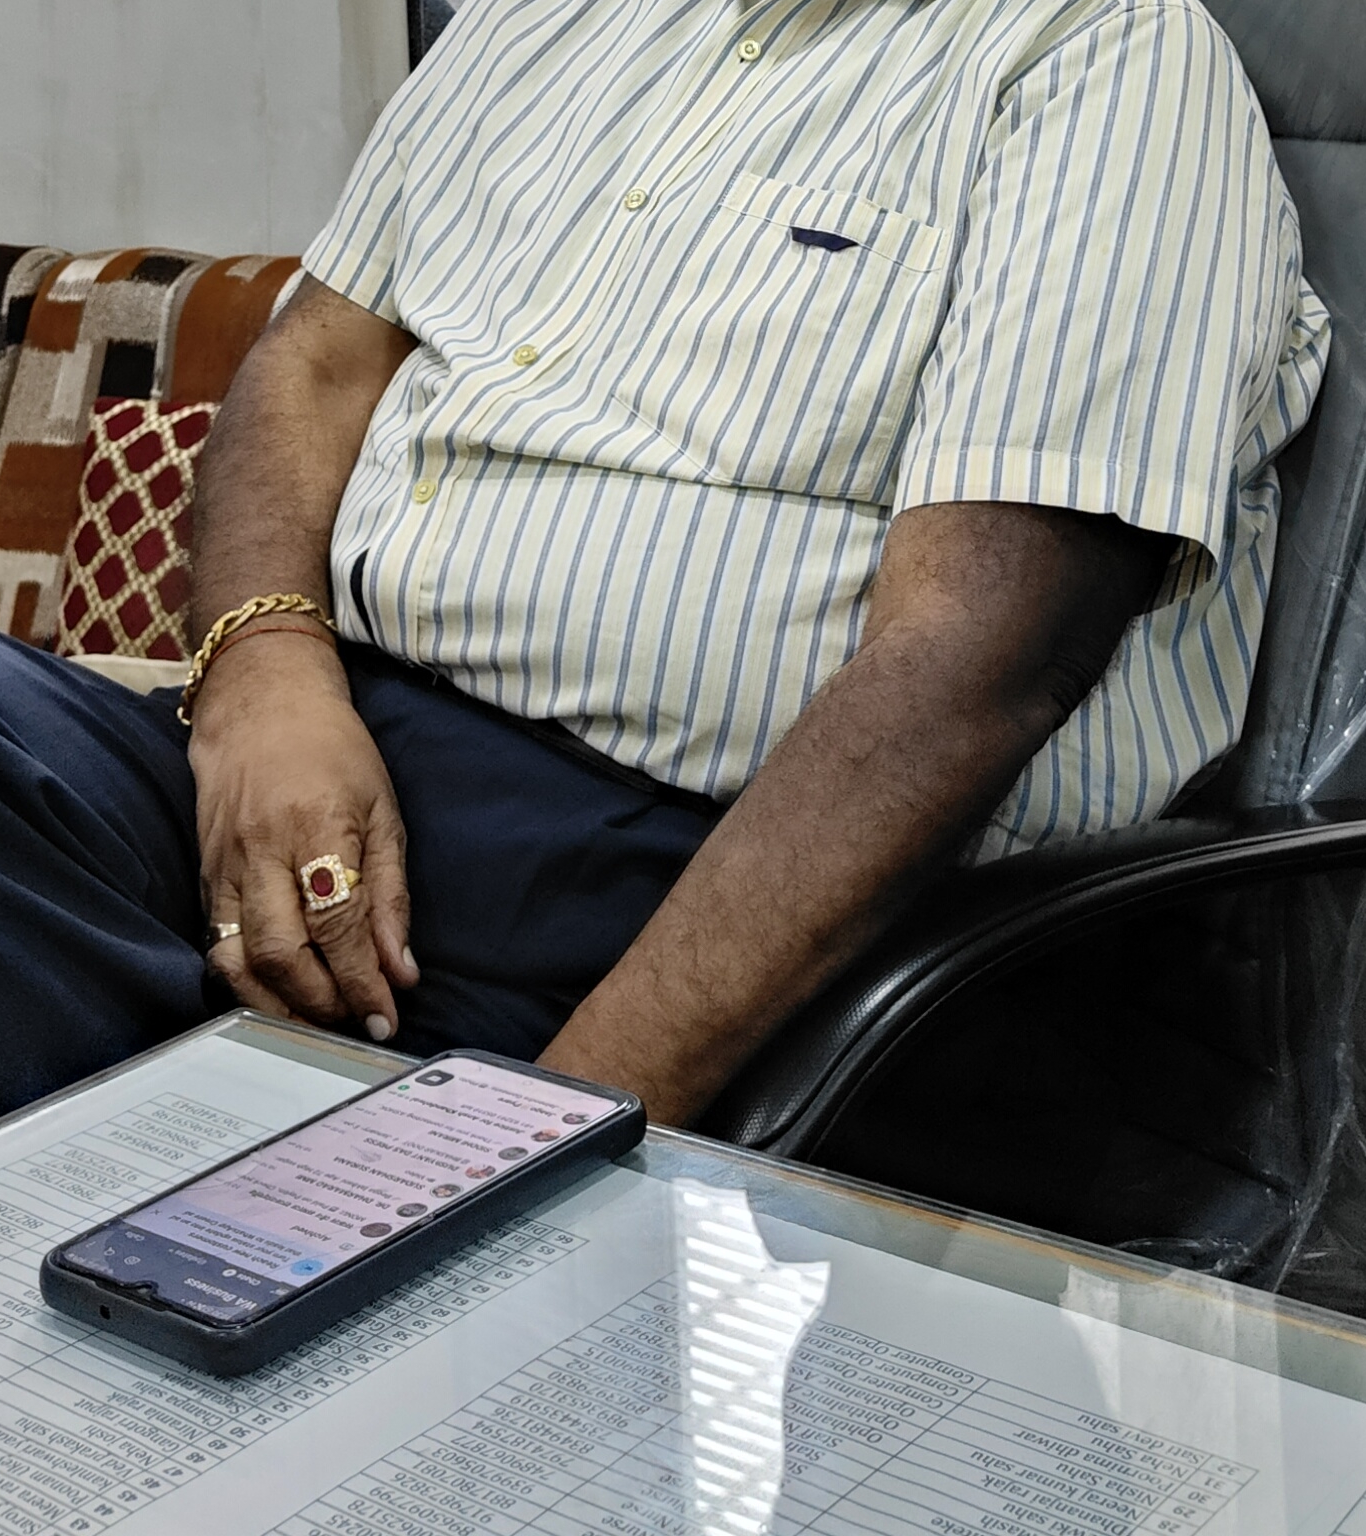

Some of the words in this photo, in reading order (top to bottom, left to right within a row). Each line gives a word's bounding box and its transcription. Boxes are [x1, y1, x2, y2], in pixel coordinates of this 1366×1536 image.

[179, 1276, 237, 1302] Business
[230, 1296, 261, 1310] WA
[887, 1348, 978, 1385] Computer
[855, 1372, 948, 1410] Computer
[69, 1397, 123, 1422] rajput
[138, 1406, 204, 1440] Niramla
[159, 1394, 228, 1428] Champa
[798, 1388, 904, 1431] Ophthalmic
[11, 1416, 53, 1438] sahu
[77, 1423, 125, 1447] joshi
[111, 1417, 185, 1453] Gangotri
[40, 1432, 113, 1464] prakash
[113, 1440, 161, 1465] Neha
[1009, 1427, 1081, 1459] dhiwar
[1164, 1445, 1205, 1464] Sati
[24, 1470, 91, 1505] Poonam
[977, 1474, 1033, 1499] rajak
[1015, 1468, 1079, 1497] kumar
[1051, 1461, 1104, 1487] Sahu
[1079, 1452, 1175, 1492] Poornima
[11, 1489, 67, 1520] Meera
[1077, 1489, 1146, 1521] Neeraj
[1101, 1479, 1160, 1506] Nisha
[1028, 1493, 1131, 1536] Dhananjai
